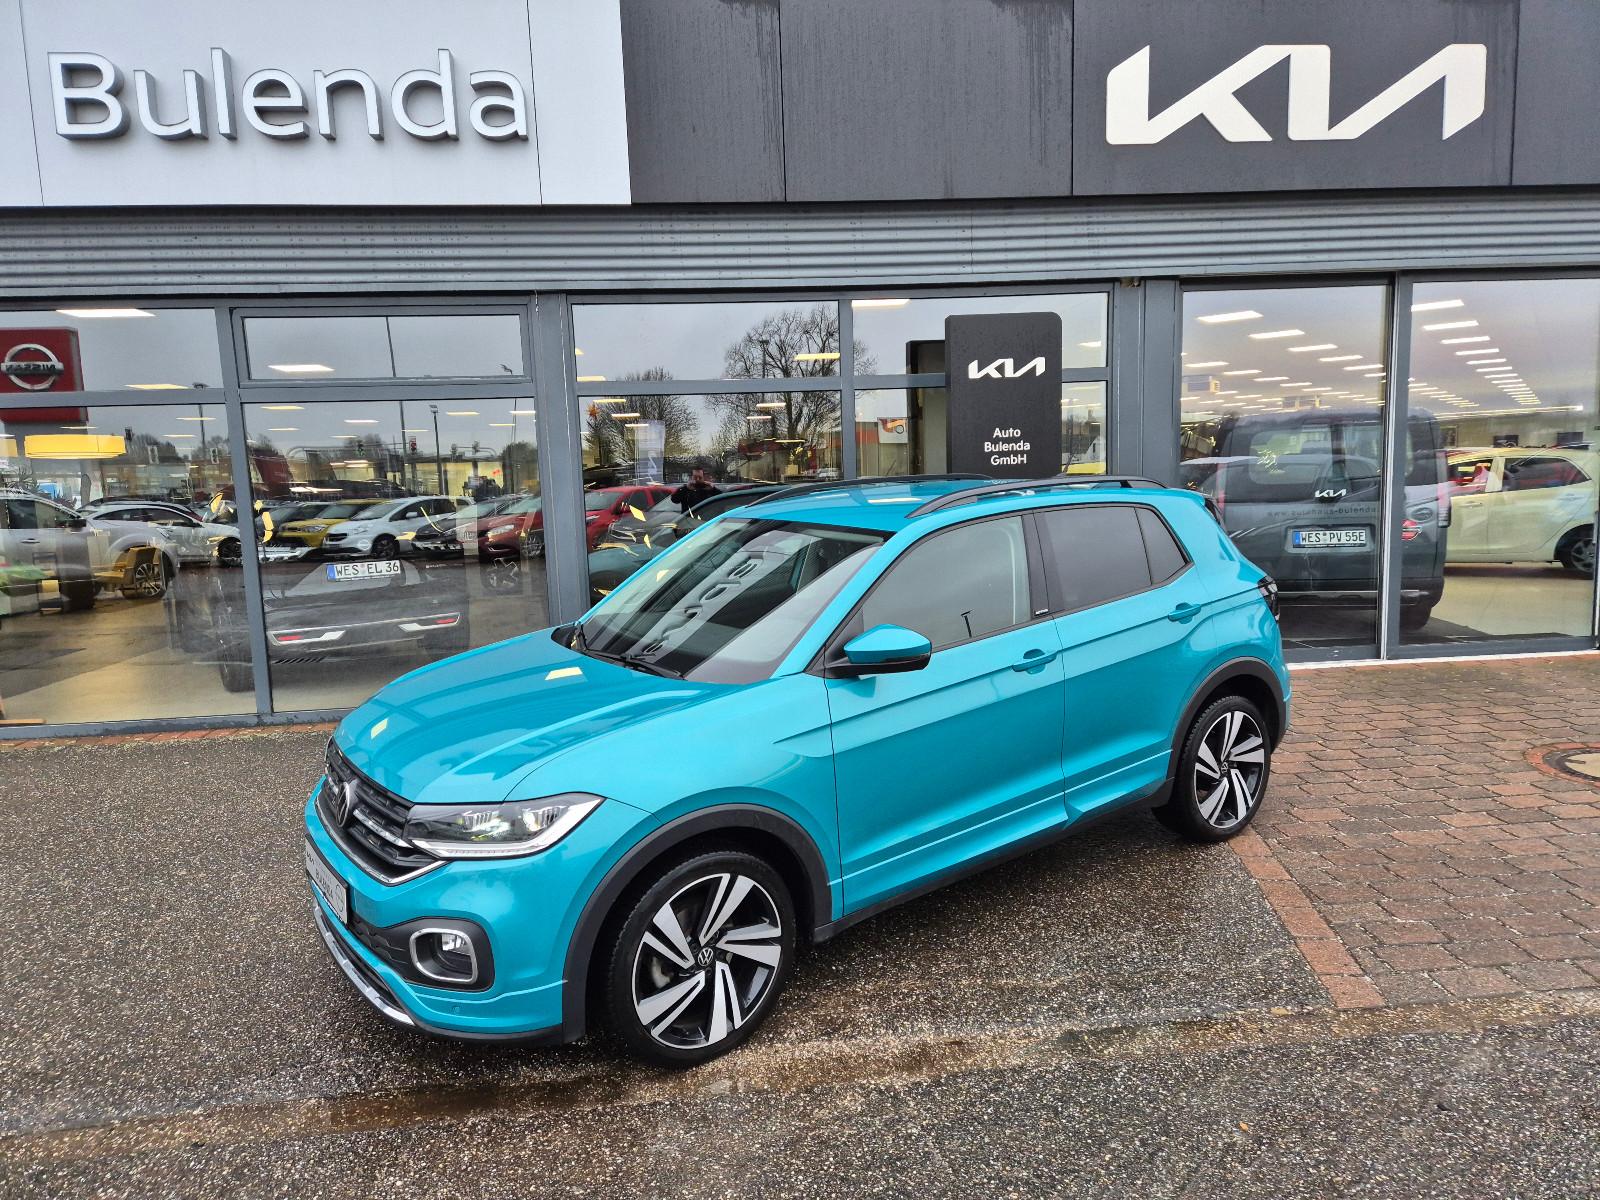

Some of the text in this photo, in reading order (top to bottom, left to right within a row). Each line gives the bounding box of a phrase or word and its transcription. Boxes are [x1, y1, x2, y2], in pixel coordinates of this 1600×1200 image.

[47, 47, 529, 142] Bulenda
[1106, 43, 1488, 145] KIA
[968, 356, 1046, 379] KIA
[993, 427, 1021, 438] Auto
[984, 440, 1031, 453] Bulenda
[990, 453, 1027, 466] GmbH
[1300, 530, 1365, 544] WES PV 55E
[335, 561, 399, 576] WES EL 36
